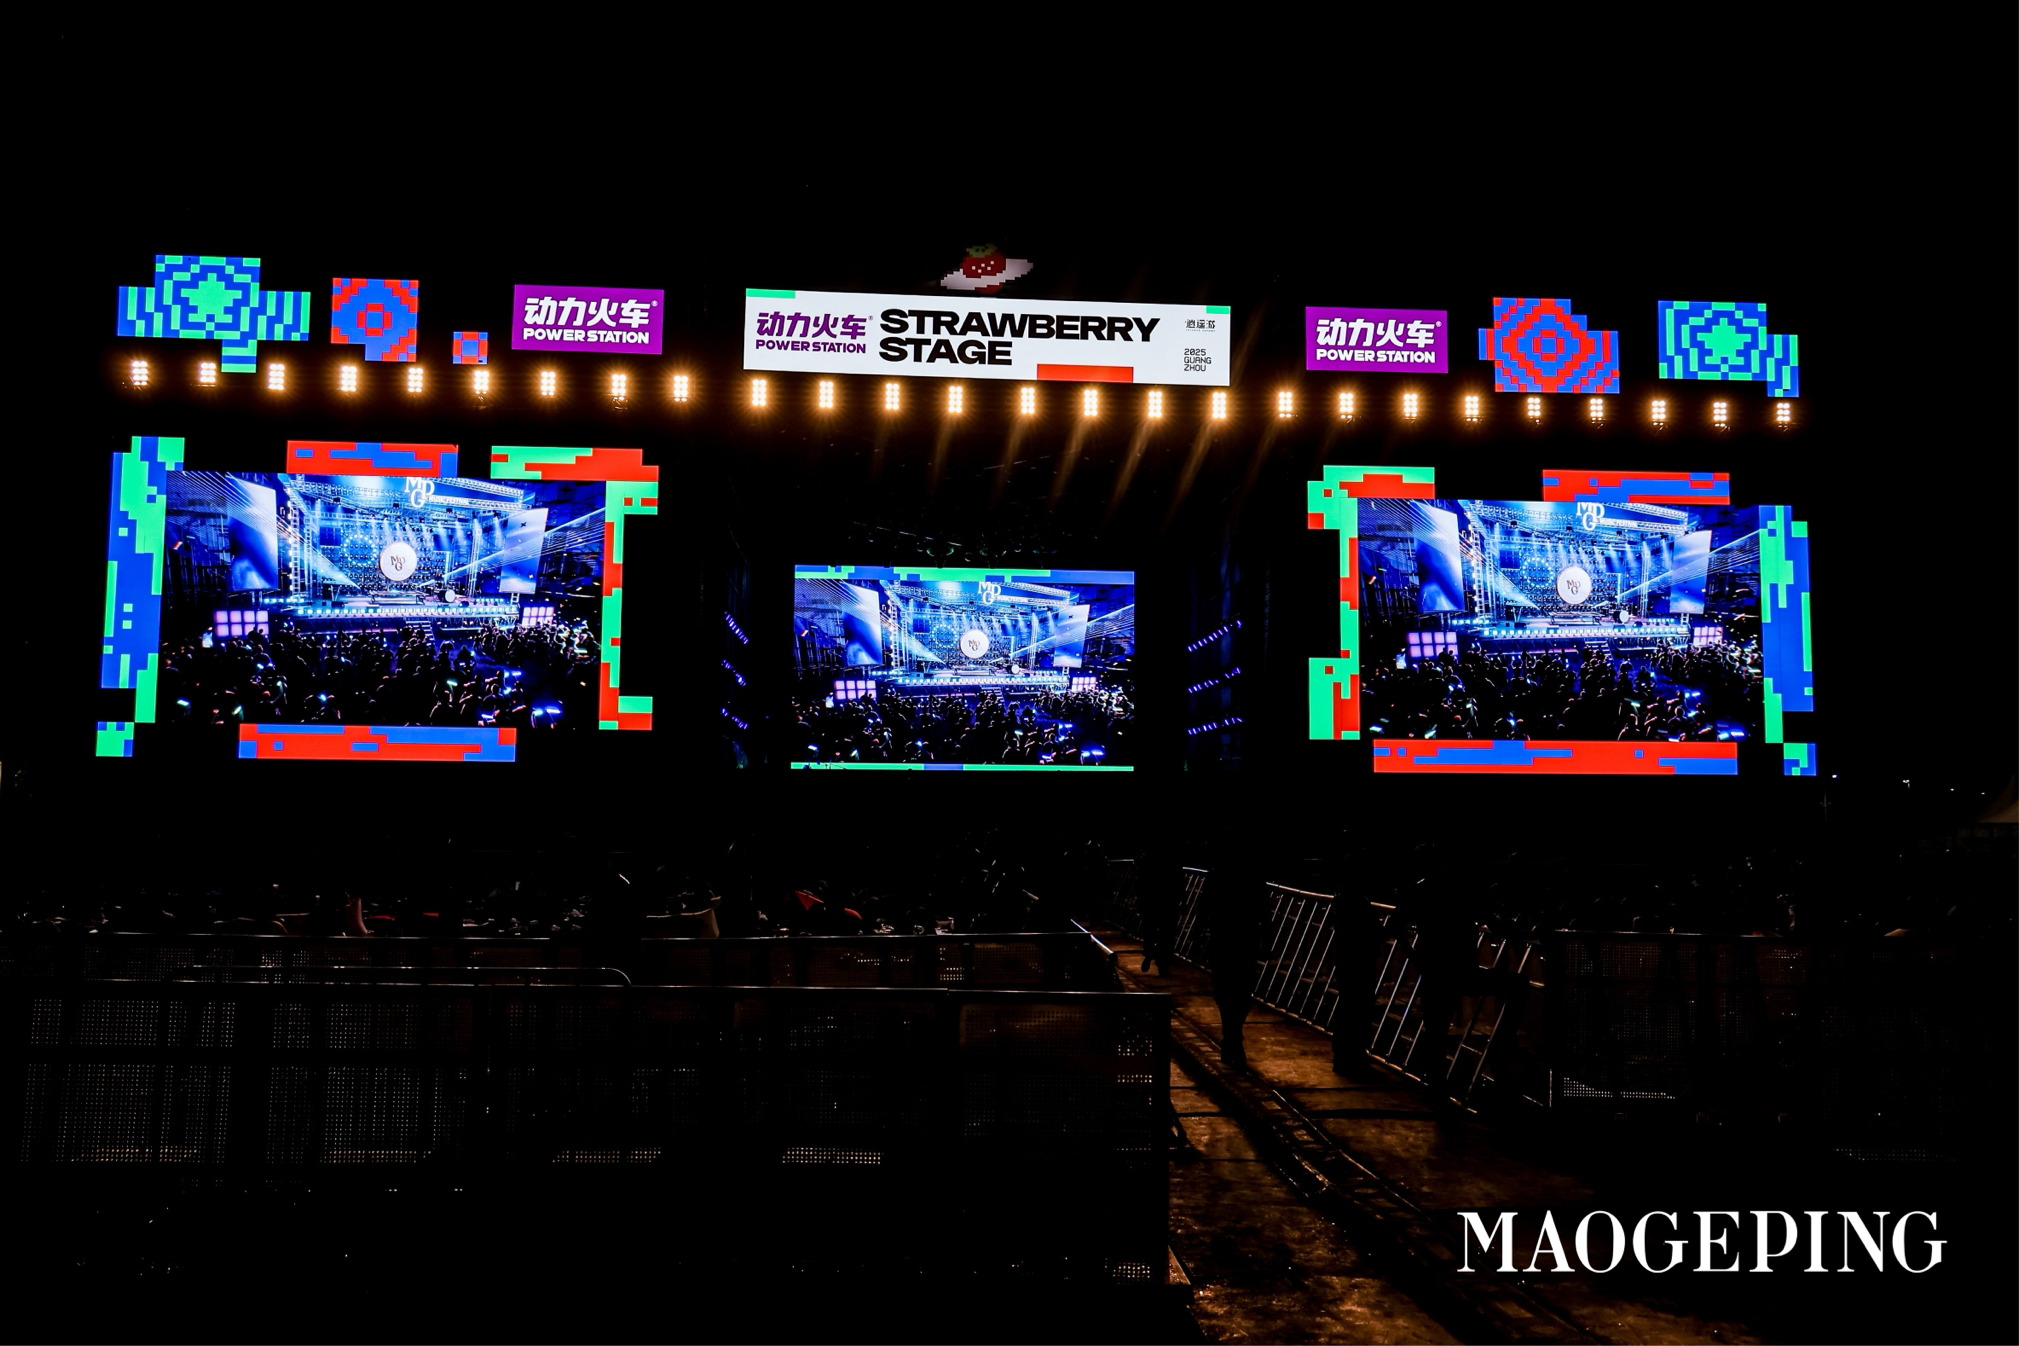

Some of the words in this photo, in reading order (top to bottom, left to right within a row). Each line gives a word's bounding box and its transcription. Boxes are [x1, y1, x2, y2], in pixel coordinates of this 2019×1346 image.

[524, 296, 650, 328] 动力火车
[756, 311, 867, 339] 动力火车
[880, 308, 1160, 342] STRAWBERRY
[523, 328, 585, 341] POWER
[587, 330, 649, 344] STATION
[756, 339, 810, 351] POWER
[812, 342, 866, 354] STATION
[1316, 318, 1435, 348] 动力火车
[879, 337, 1013, 365] STAGE
[1316, 349, 1375, 361] POWER
[1377, 351, 1435, 363] STATION
